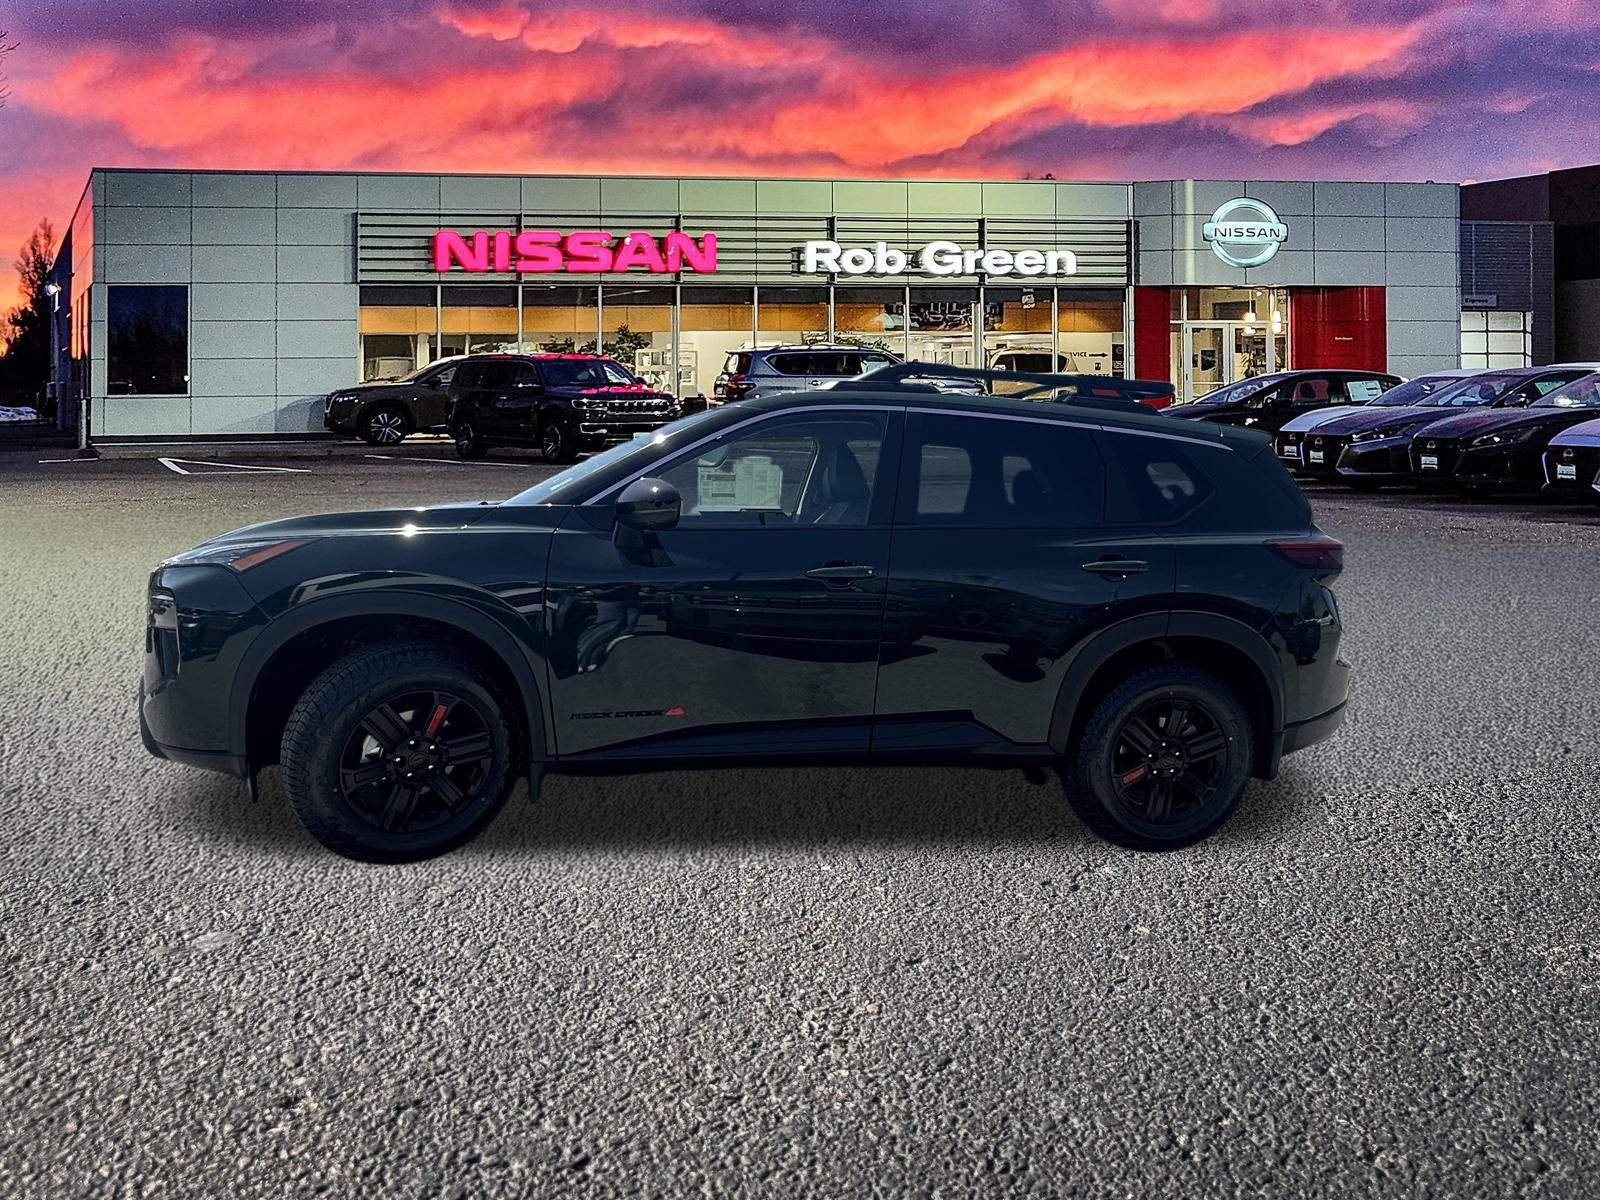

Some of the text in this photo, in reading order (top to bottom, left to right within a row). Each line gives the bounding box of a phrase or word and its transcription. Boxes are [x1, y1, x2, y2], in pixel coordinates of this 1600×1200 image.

[1214, 227, 1280, 238] NISSAN
[433, 230, 718, 273] NISSAN
[804, 240, 1078, 276] Rob Green
